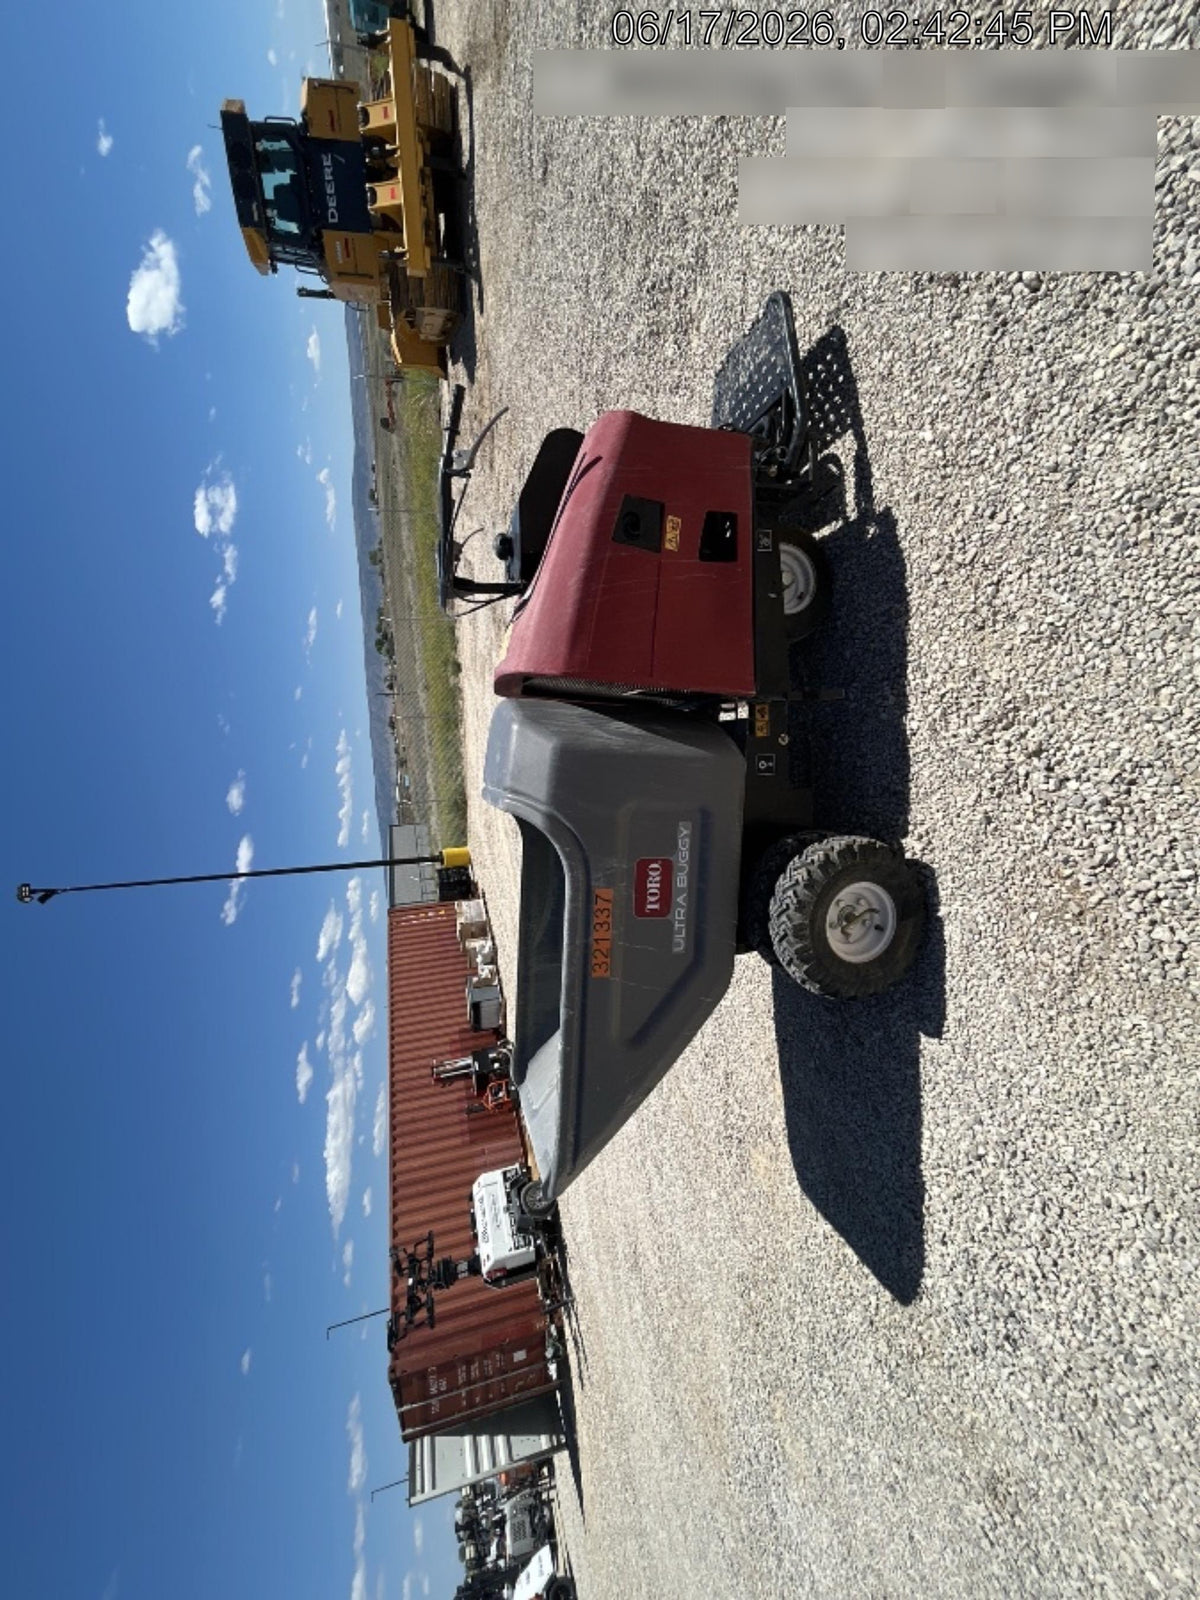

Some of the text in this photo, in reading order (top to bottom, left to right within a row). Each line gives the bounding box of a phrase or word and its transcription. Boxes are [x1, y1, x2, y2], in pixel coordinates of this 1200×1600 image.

[321, 153, 339, 223] DEERE
[645, 863, 663, 912] TORO
[673, 826, 691, 953] ULTRA BUGGY
[593, 893, 613, 973] 321337
